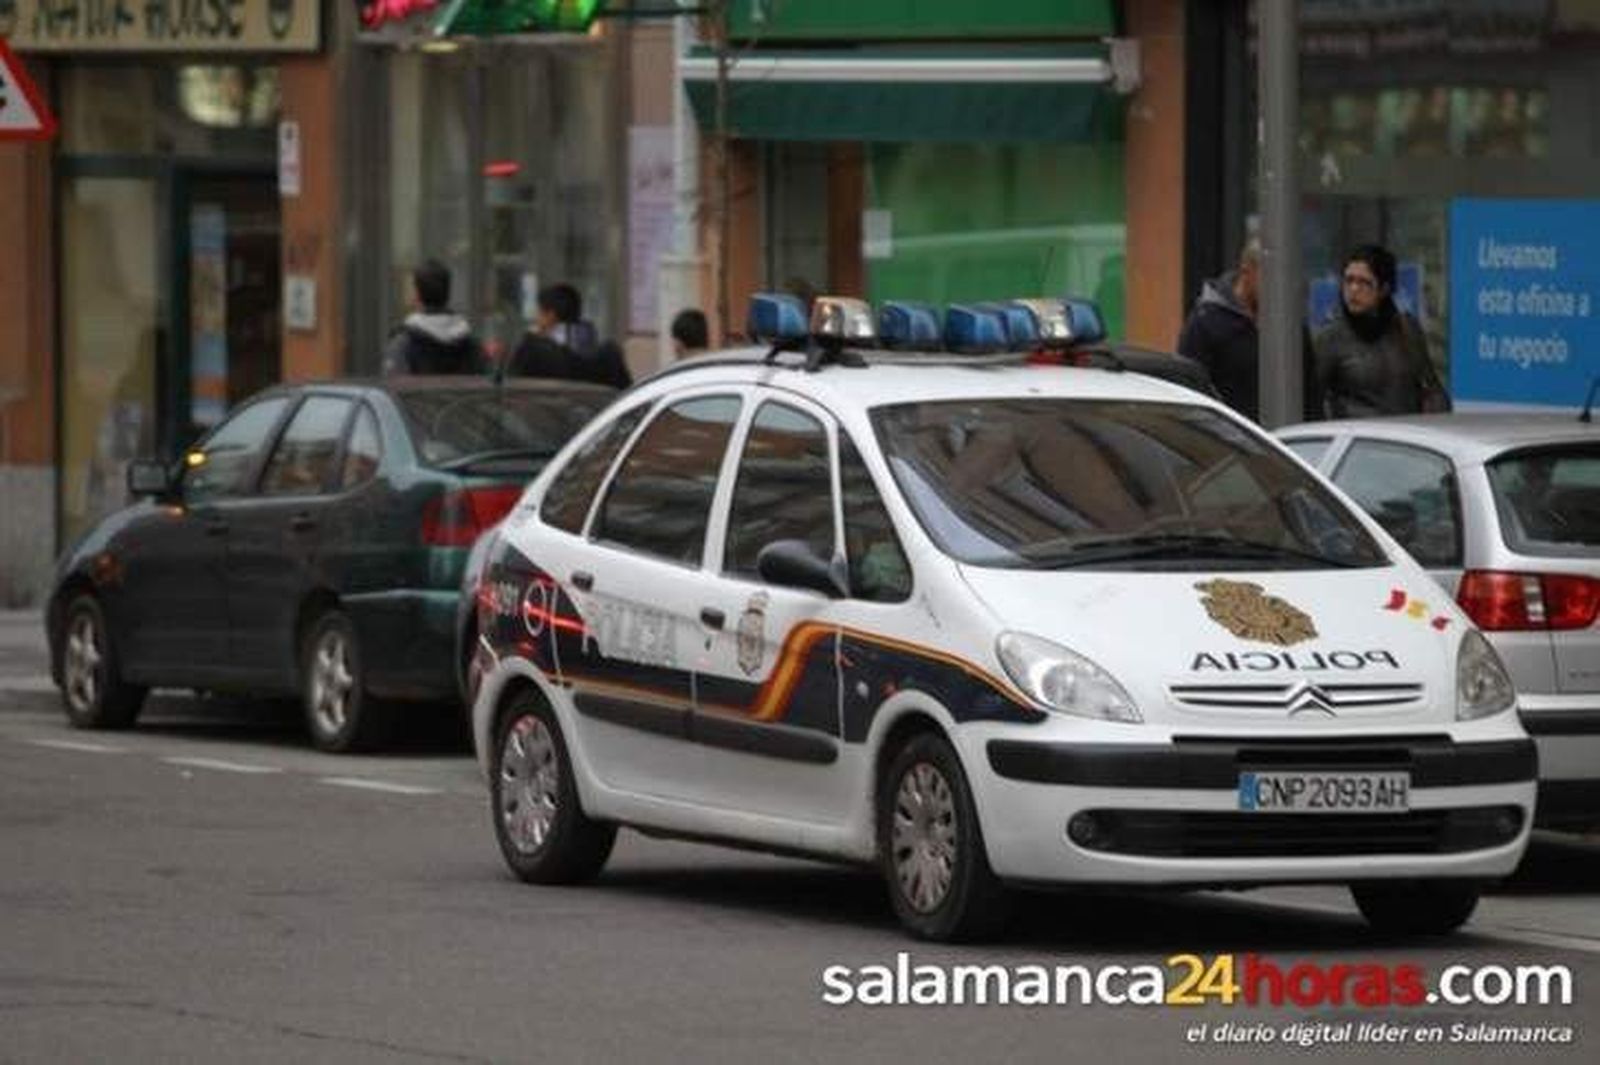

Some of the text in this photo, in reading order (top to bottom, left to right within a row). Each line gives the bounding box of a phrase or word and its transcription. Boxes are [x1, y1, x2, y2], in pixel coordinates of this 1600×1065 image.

[1477, 237, 1557, 269] Llevamos
[1477, 283, 1590, 317] esta oficina a
[1479, 332, 1568, 369] tu negocio
